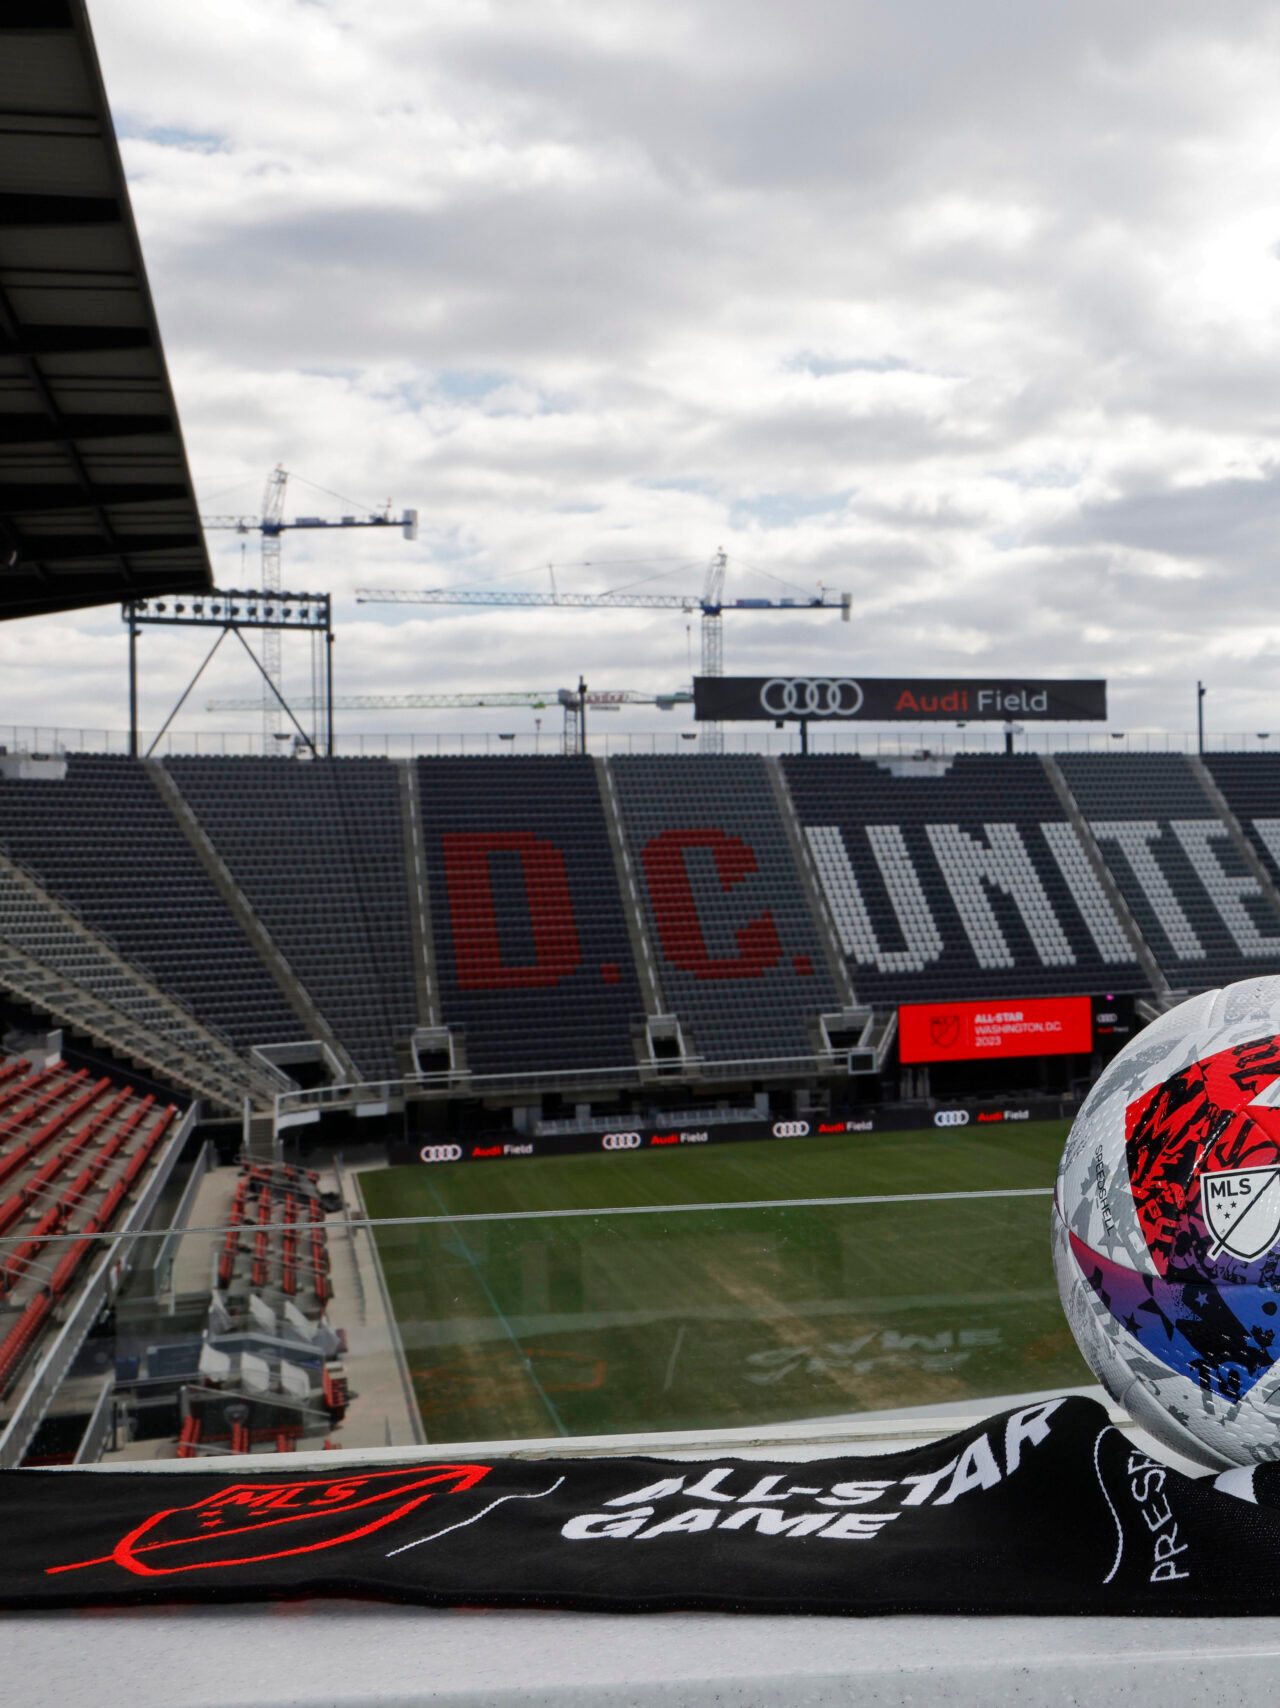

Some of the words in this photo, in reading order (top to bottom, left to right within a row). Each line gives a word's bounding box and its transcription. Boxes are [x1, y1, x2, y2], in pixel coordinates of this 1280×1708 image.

[895, 690, 969, 712] Audi
[977, 690, 1048, 712] Field
[442, 829, 814, 990] D.C.
[975, 1012, 1024, 1024] ALL-STAR
[975, 1036, 1001, 1047] 2023
[818, 1122, 845, 1133] Audi
[847, 1120, 873, 1131] Field
[978, 1112, 1002, 1122] Audi
[1004, 1110, 1029, 1121] Field
[651, 1134, 679, 1145] Audi
[680, 1132, 708, 1143] Field
[472, 1146, 501, 1157] Audi
[503, 1143, 533, 1155] Field
[1094, 1144, 1116, 1237] SPEEDSHELL
[1210, 1177, 1252, 1199] MLS
[603, 1398, 1067, 1506] ALL-STAR
[209, 1479, 369, 1508] MLS
[560, 1506, 902, 1540] GAME
